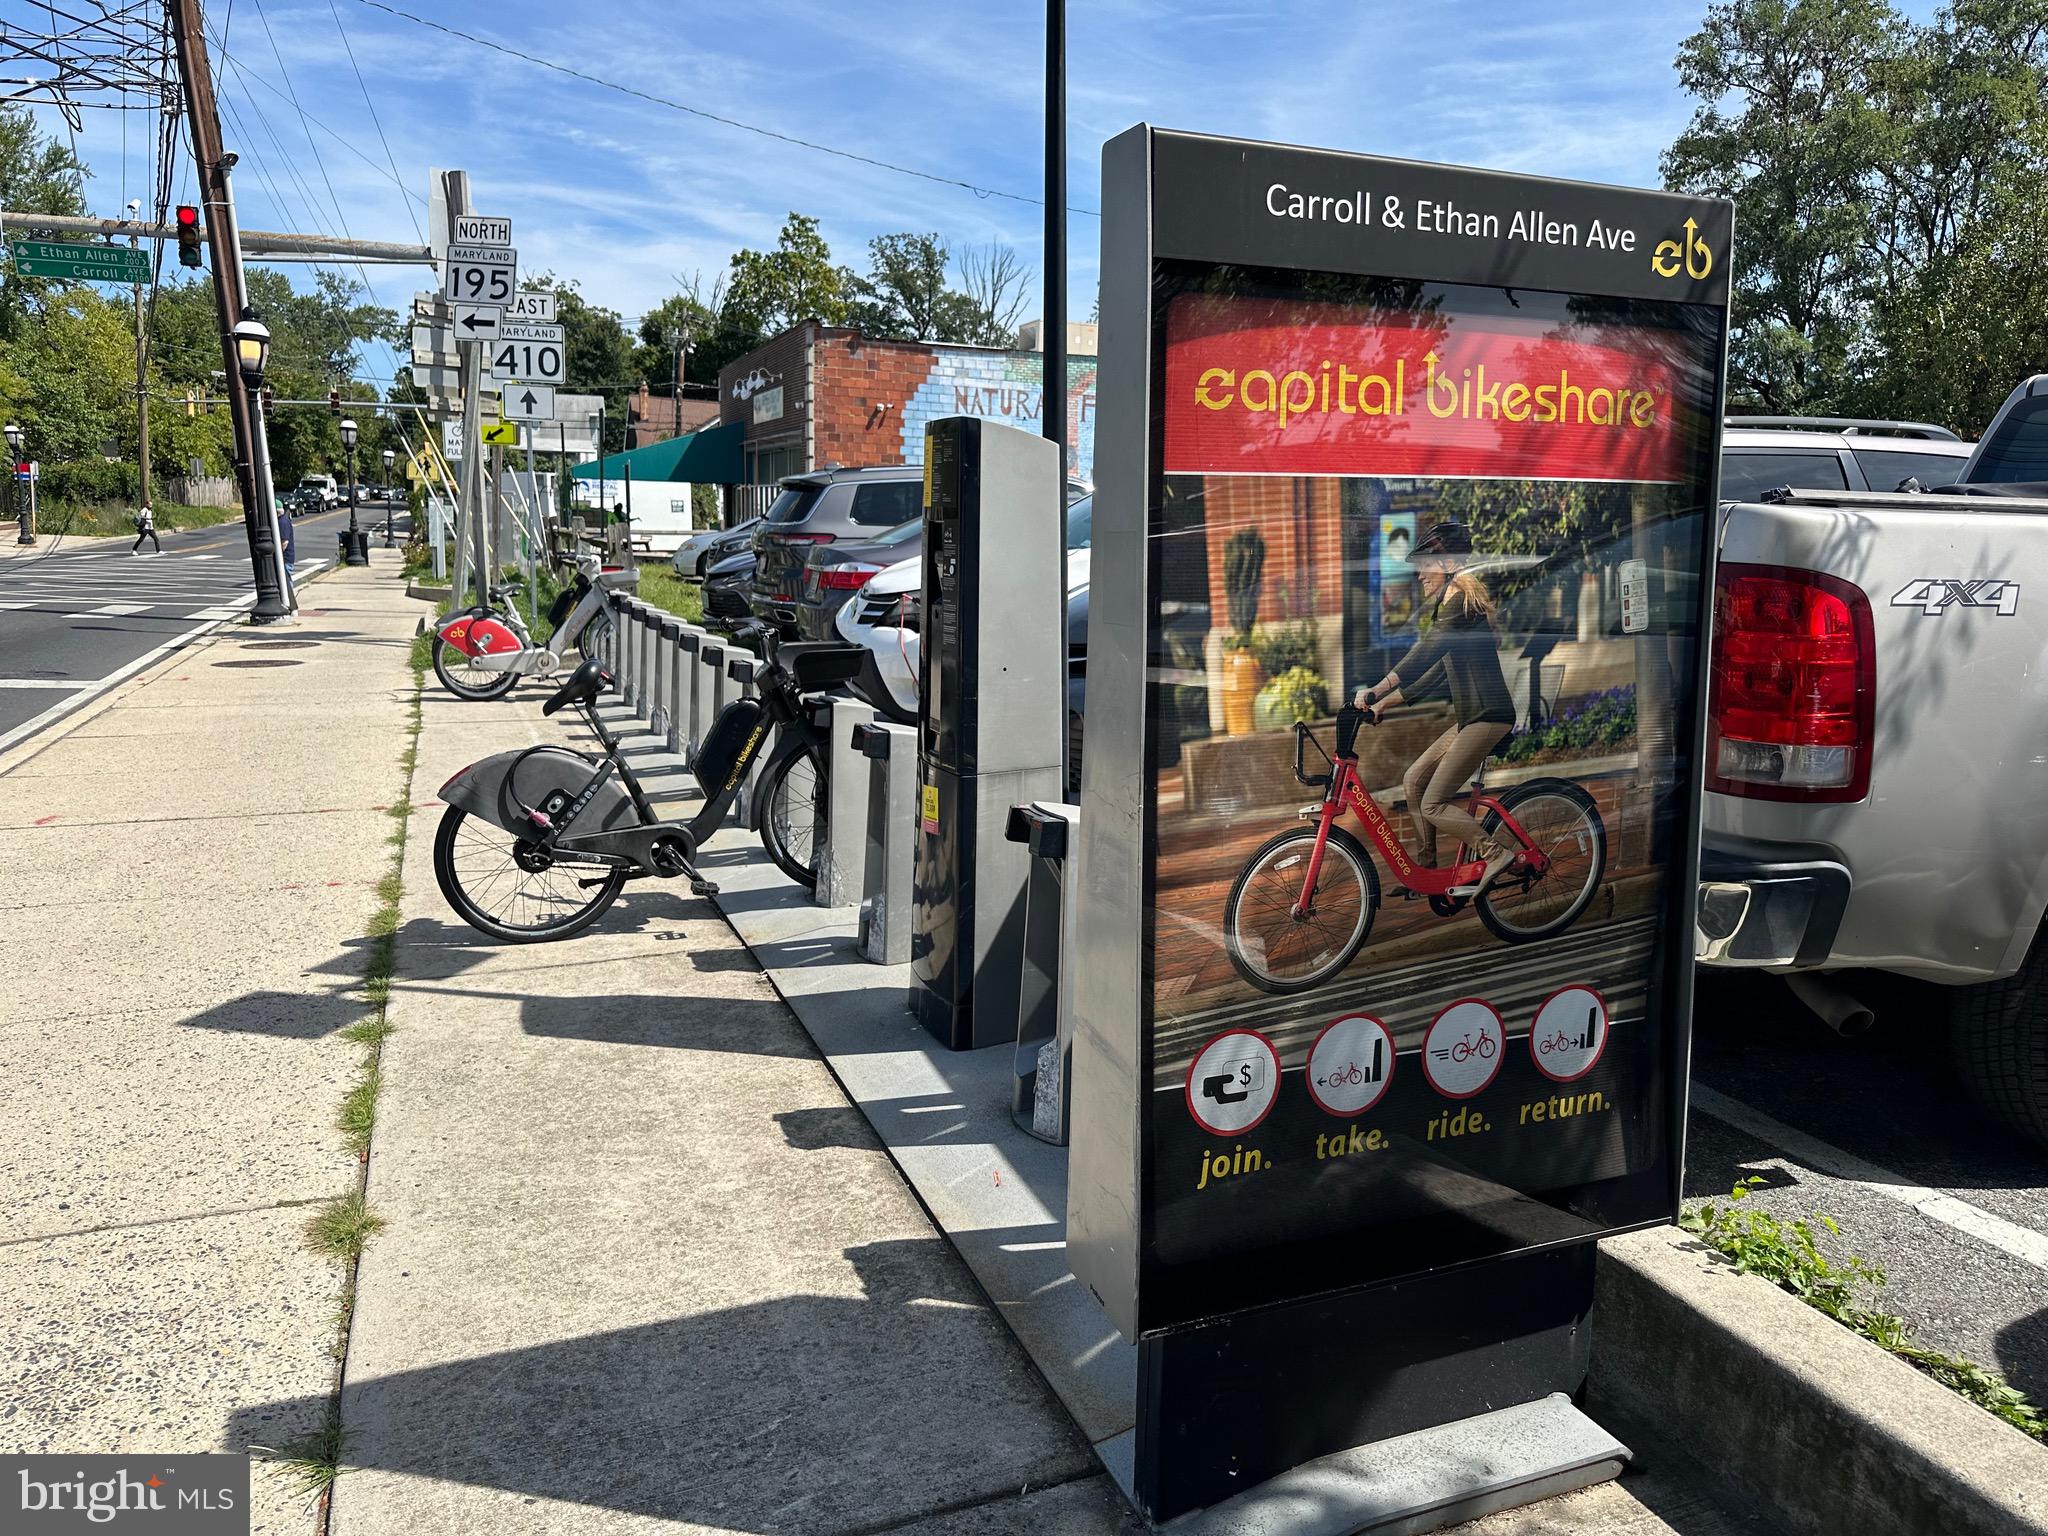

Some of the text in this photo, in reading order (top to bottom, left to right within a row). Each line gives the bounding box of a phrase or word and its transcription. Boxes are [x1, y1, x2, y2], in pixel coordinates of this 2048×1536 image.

[458, 222, 507, 240] NORTH
[1266, 184, 1636, 252] Carroll & Ethan Allen Ave
[40, 247, 142, 261] Ethan Allen AVE
[124, 257, 140, 266] 200
[454, 249, 509, 262] MARYLAND
[73, 265, 145, 279] Carroll AVE
[452, 267, 509, 300] 195
[495, 344, 560, 377] 410
[954, 385, 1043, 418] NATURA
[1195, 358, 1404, 429] capital
[1422, 350, 1655, 428] bikeshare
[725, 726, 763, 790] capital bikeshare
[1351, 784, 1411, 876] capital bikeshare
[1197, 1091, 1610, 1190] join. take. ride. return.
